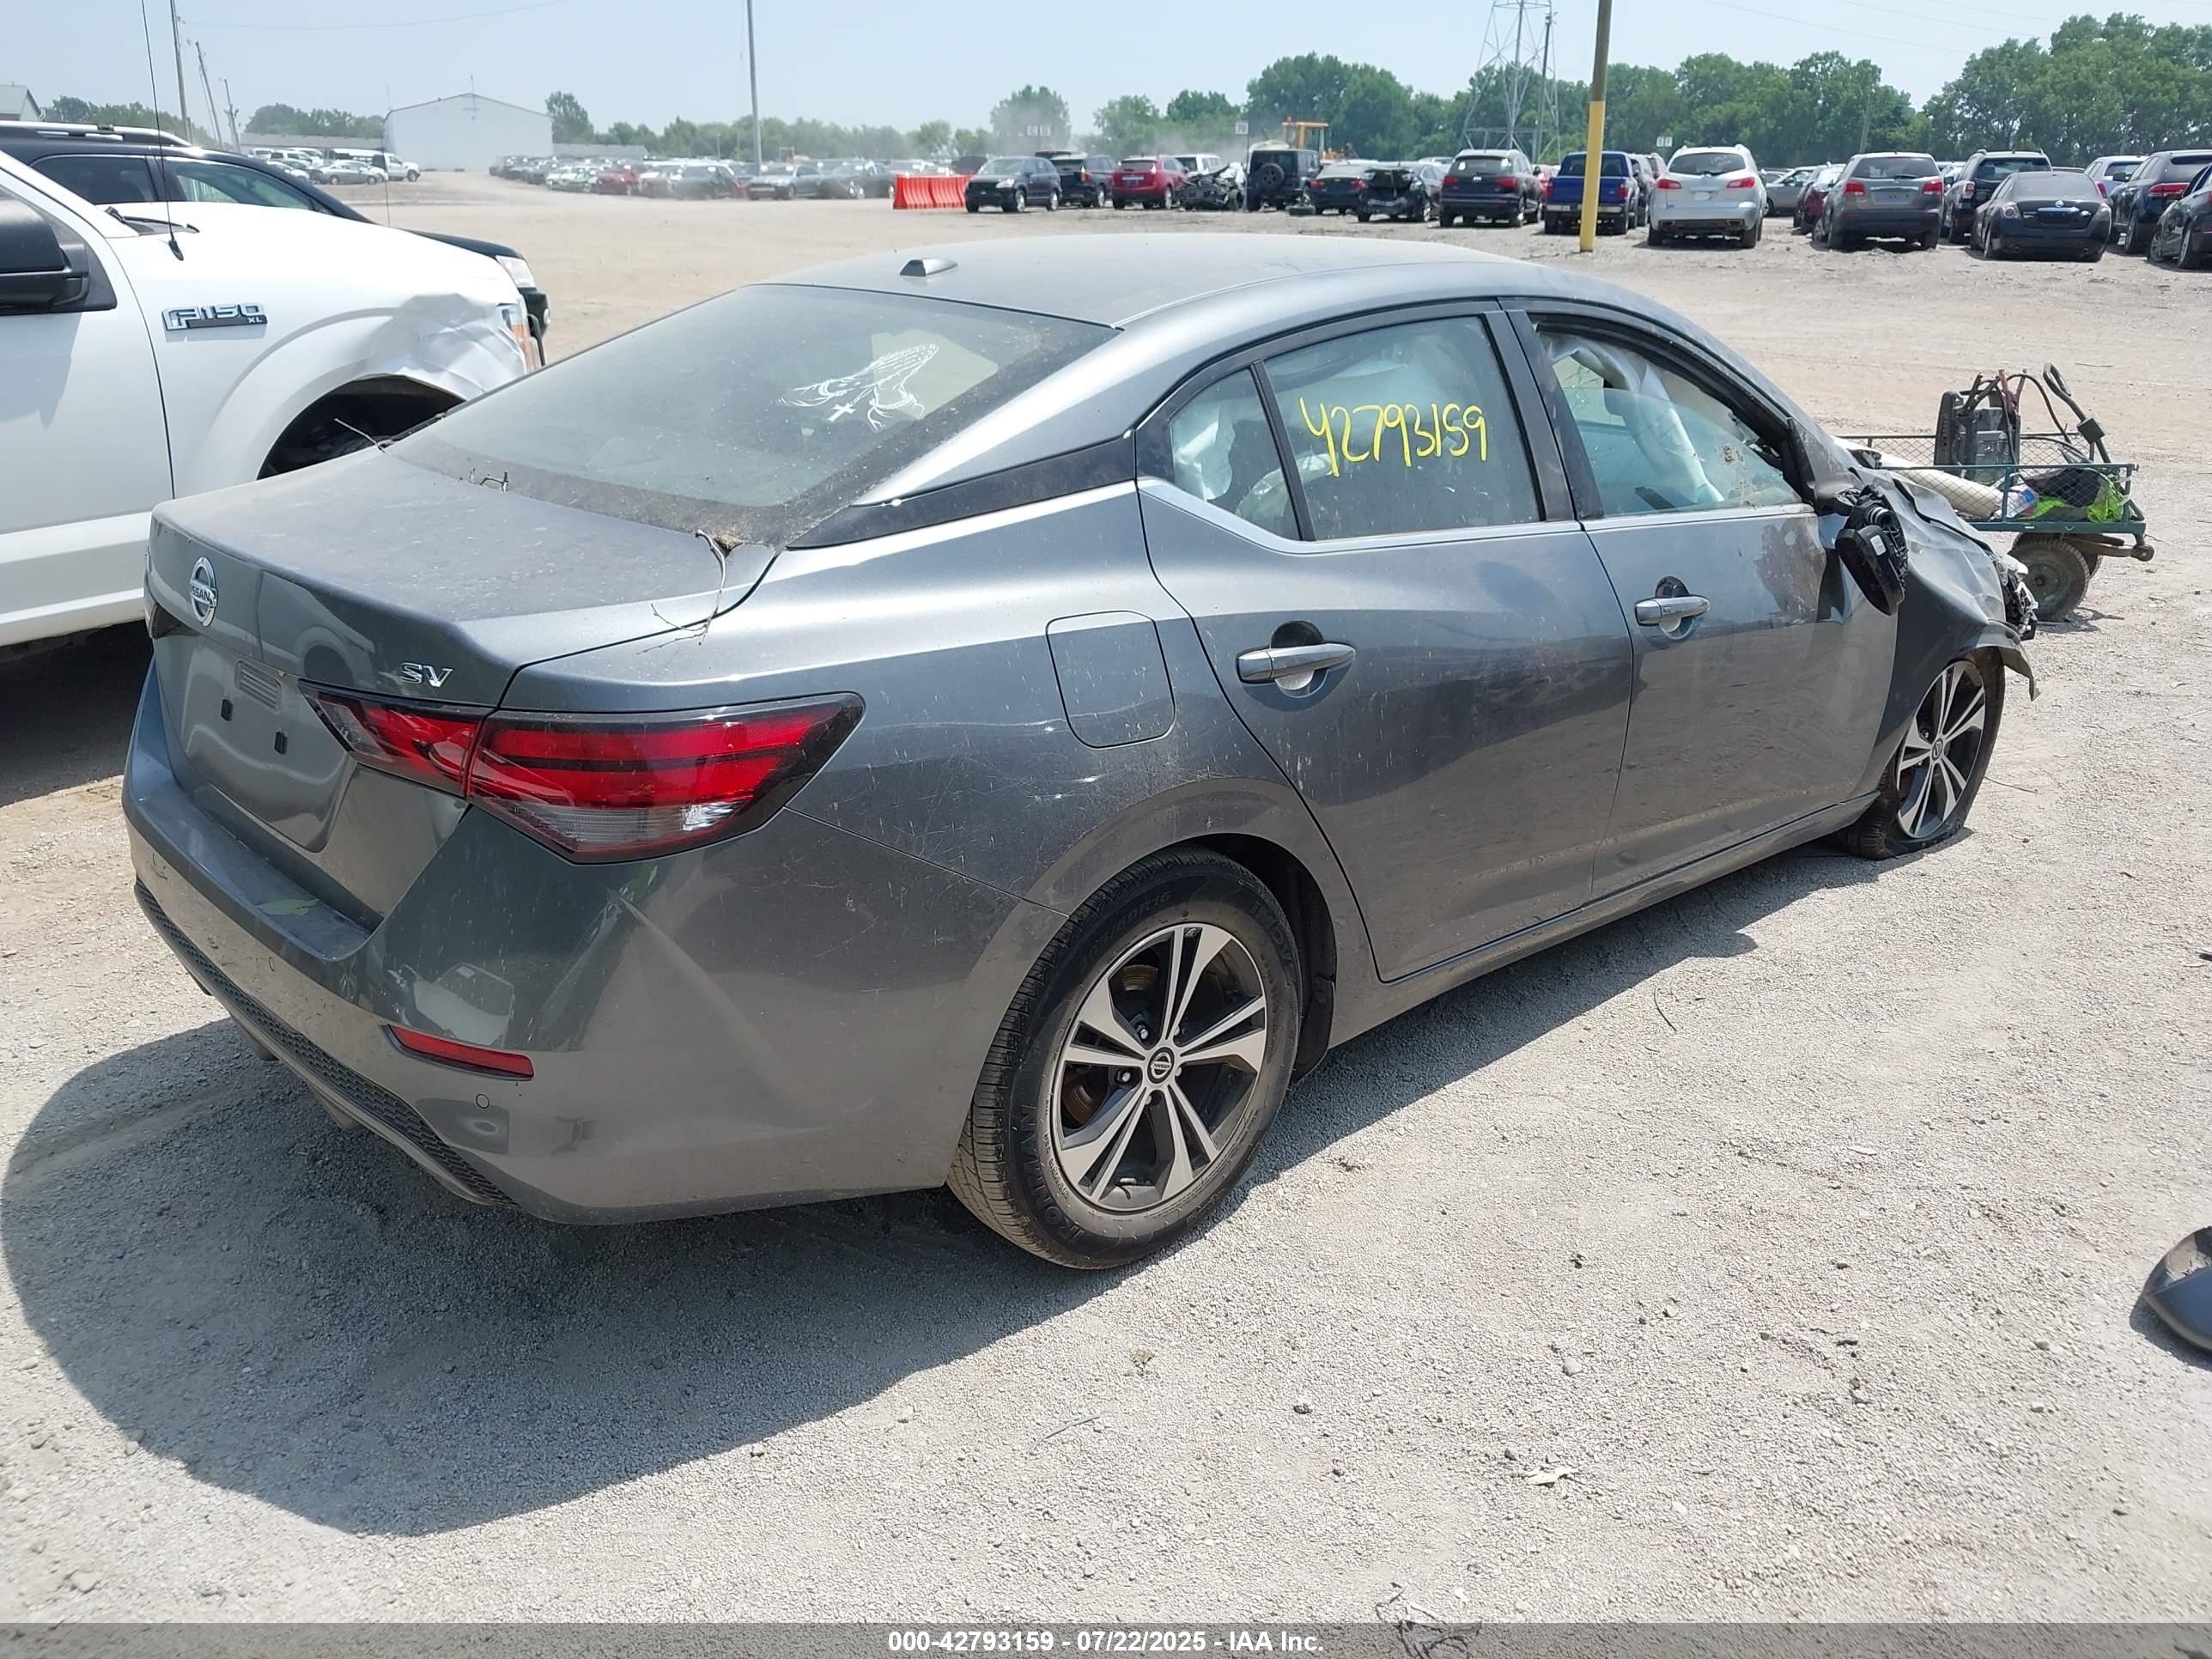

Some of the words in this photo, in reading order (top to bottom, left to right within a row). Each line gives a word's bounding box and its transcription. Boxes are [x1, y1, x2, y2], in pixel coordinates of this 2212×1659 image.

[1298, 398, 1487, 477] 42793159
[399, 662, 454, 687] SV
[1020, 1103, 1085, 1243] IRONMAN
